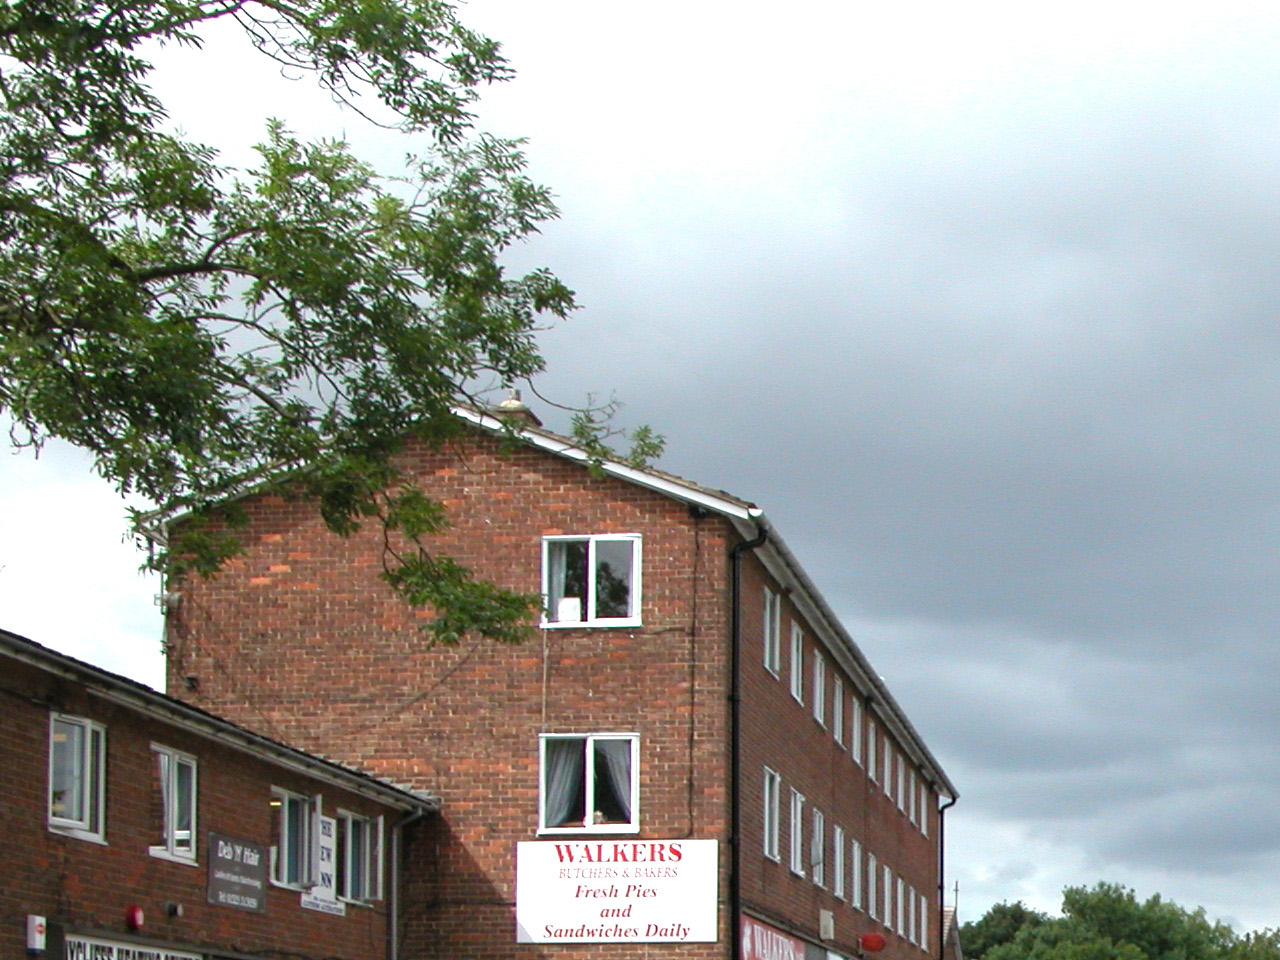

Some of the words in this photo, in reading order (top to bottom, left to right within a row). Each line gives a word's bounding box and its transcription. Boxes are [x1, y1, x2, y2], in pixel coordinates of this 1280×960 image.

[218, 840, 234, 860] Deb
[243, 847, 260, 867] Hair
[554, 843, 683, 863] WALKERS
[559, 867, 619, 879] BUTCHERS
[622, 868, 630, 878] &
[634, 866, 679, 878] BAKERS
[575, 884, 619, 899] Fresh
[625, 884, 658, 898] Pies
[599, 904, 633, 918] and
[543, 923, 640, 939] Sandwiches
[645, 923, 691, 941] Daily
